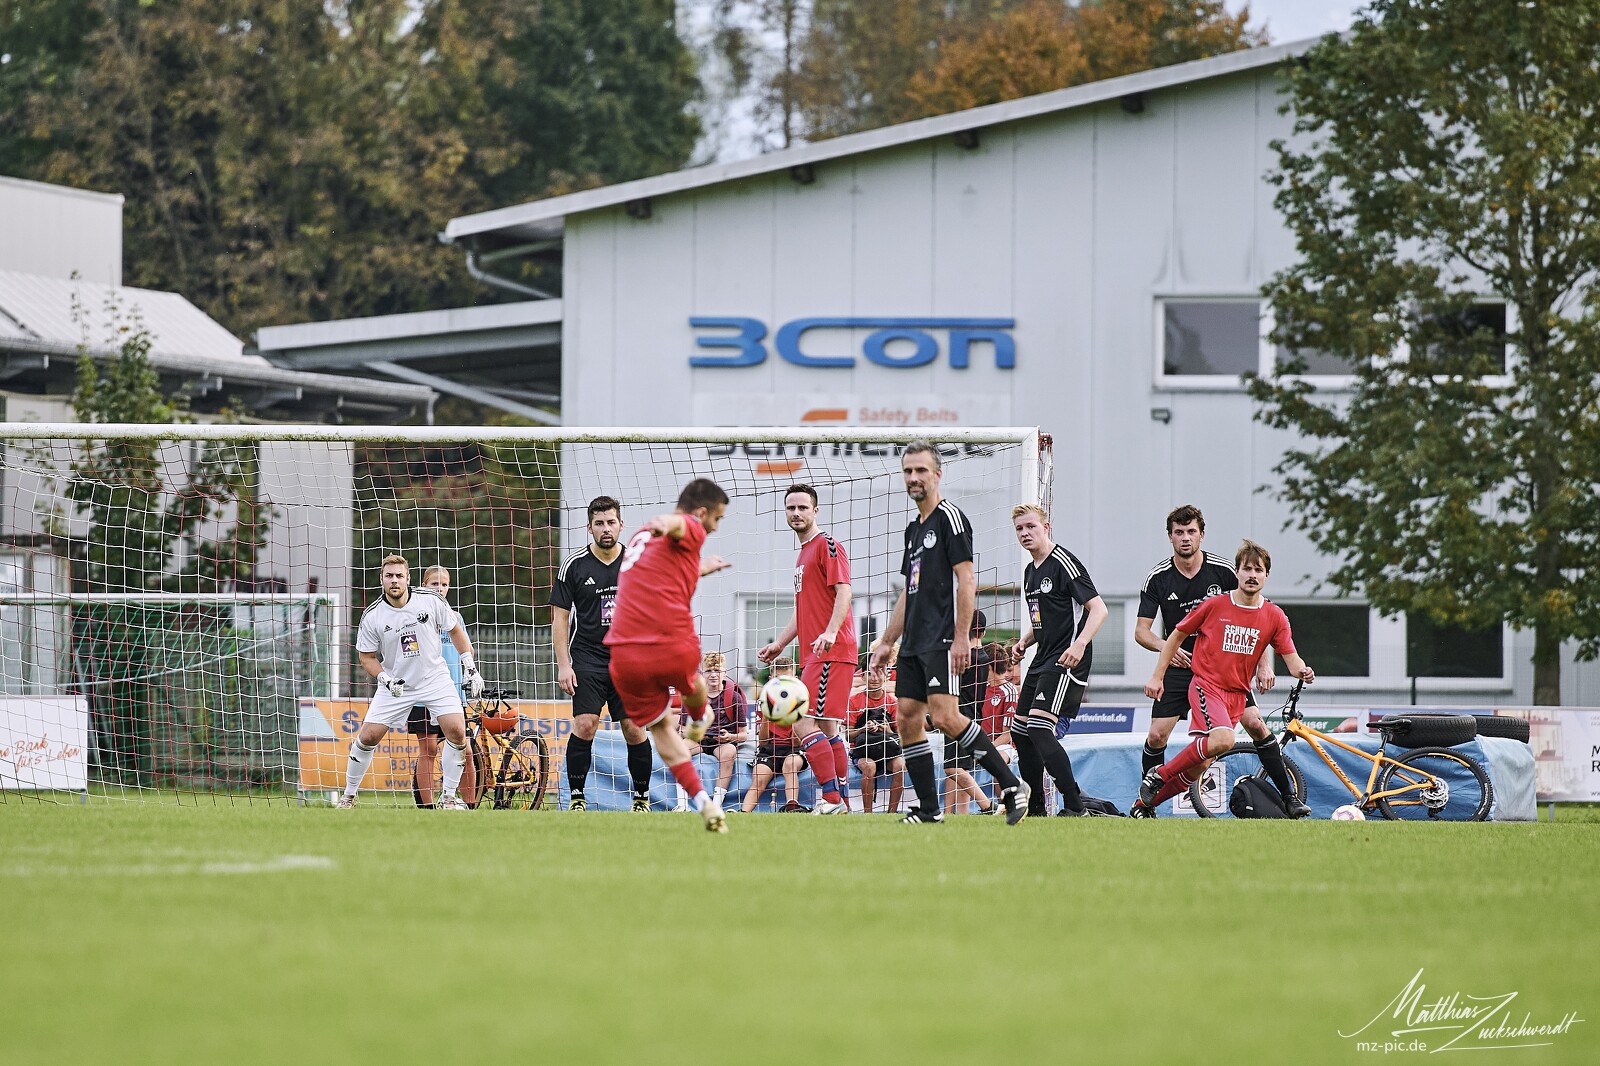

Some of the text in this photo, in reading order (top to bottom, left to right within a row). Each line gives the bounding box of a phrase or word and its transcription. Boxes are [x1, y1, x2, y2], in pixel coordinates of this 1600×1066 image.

[859, 408, 959, 423] Safety Belts
[1225, 624, 1260, 637] SCHWARZ
[1224, 633, 1257, 647] HOME
[15, 733, 48, 755] Bank
[48, 743, 80, 762] Leben
